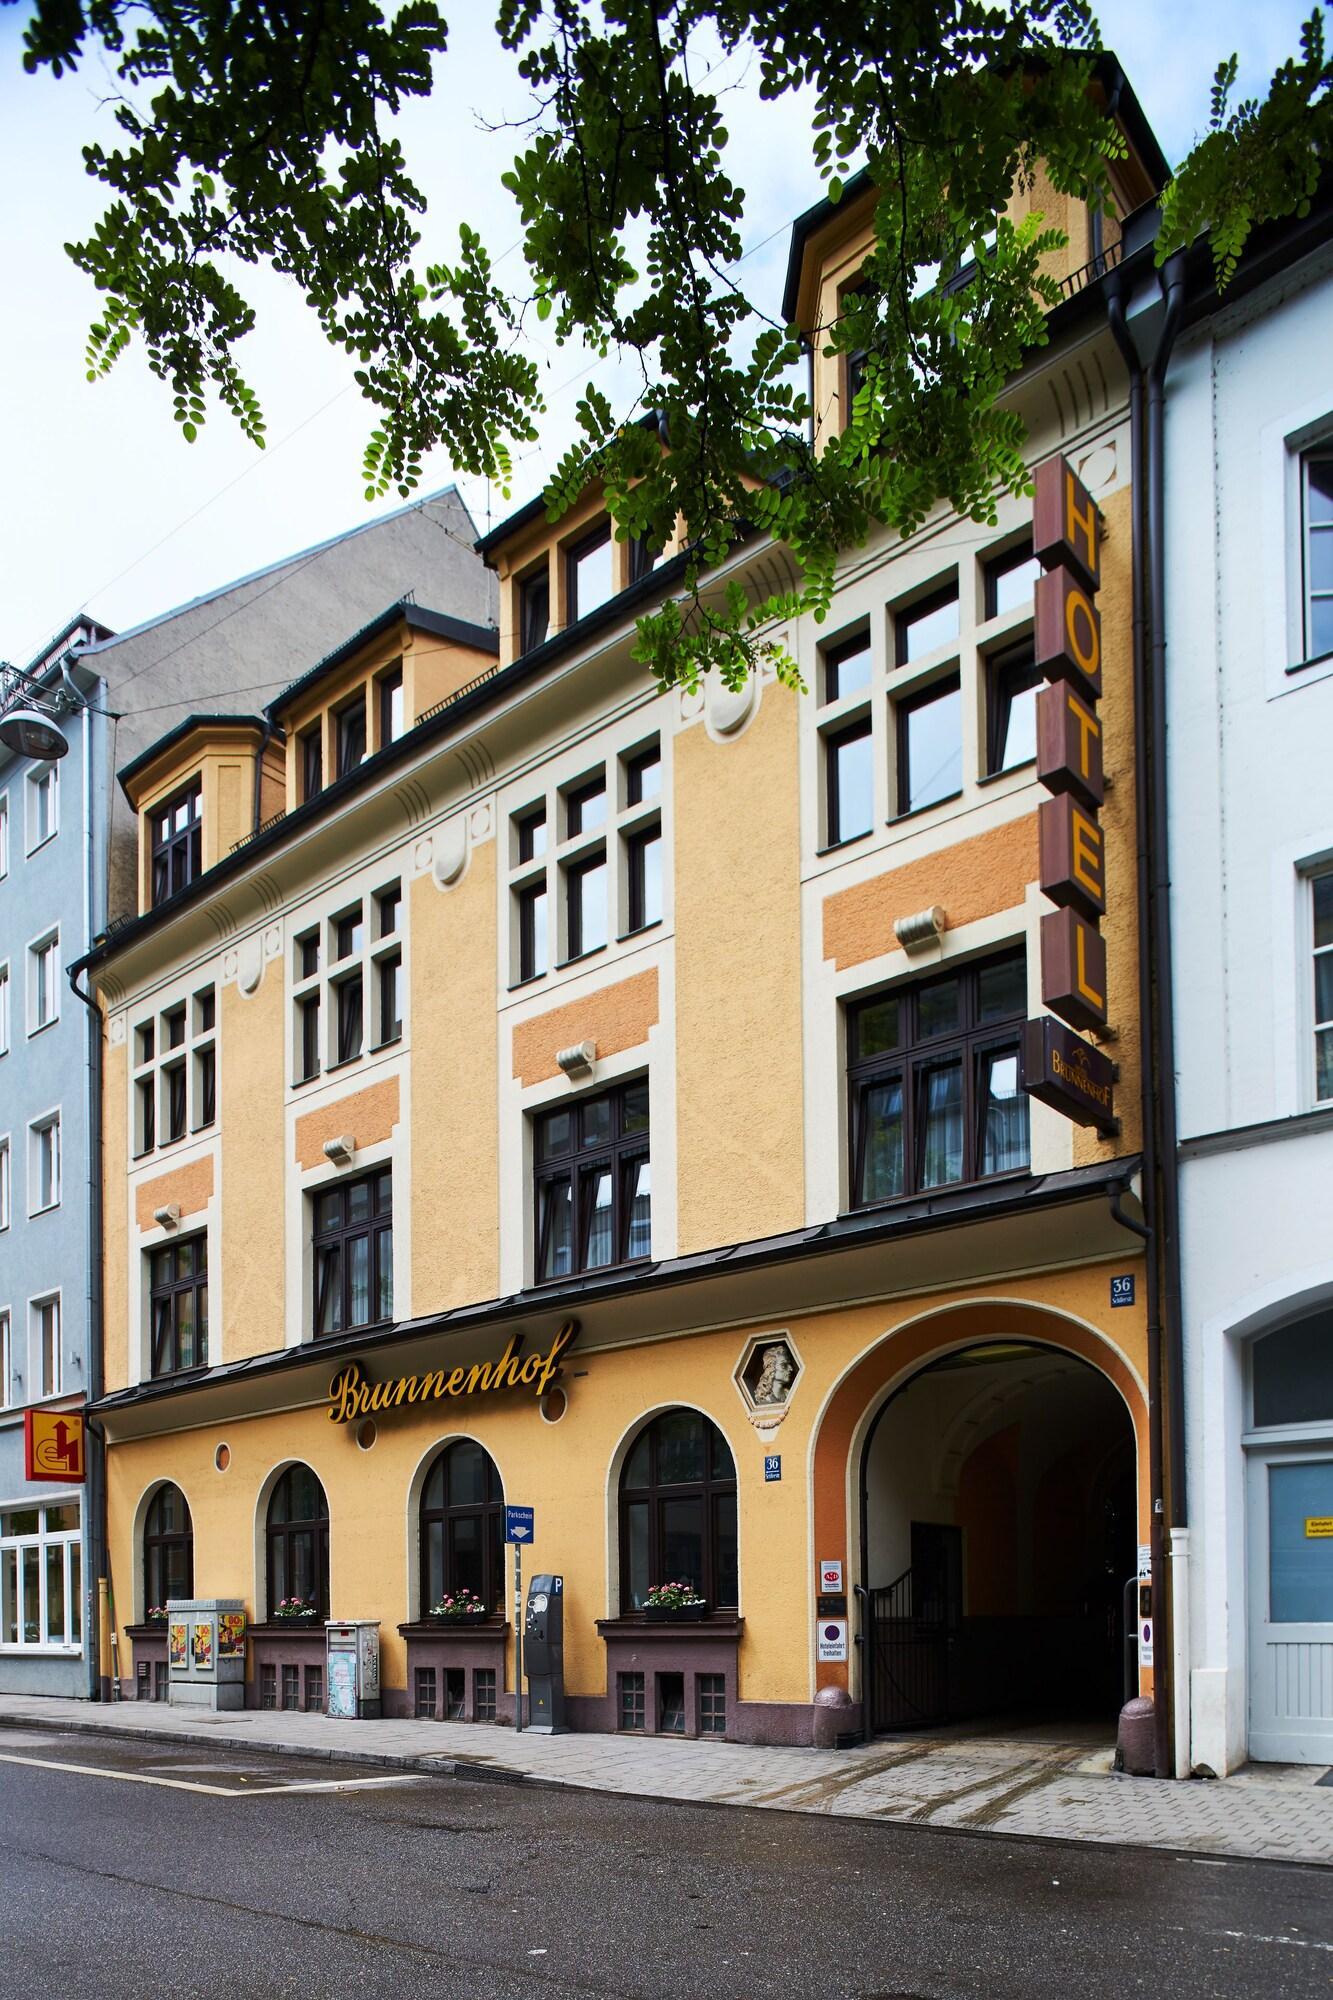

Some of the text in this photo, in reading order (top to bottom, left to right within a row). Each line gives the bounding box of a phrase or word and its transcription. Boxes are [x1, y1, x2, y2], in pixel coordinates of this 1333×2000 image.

[1066, 470, 1103, 1009] HOTEL
[1113, 1277, 1131, 1293] 36
[327, 1319, 580, 1424] Brunnenhof
[766, 1457, 779, 1470] 36
[507, 1510, 533, 1520] Parkschein
[555, 1578, 562, 1593] P
